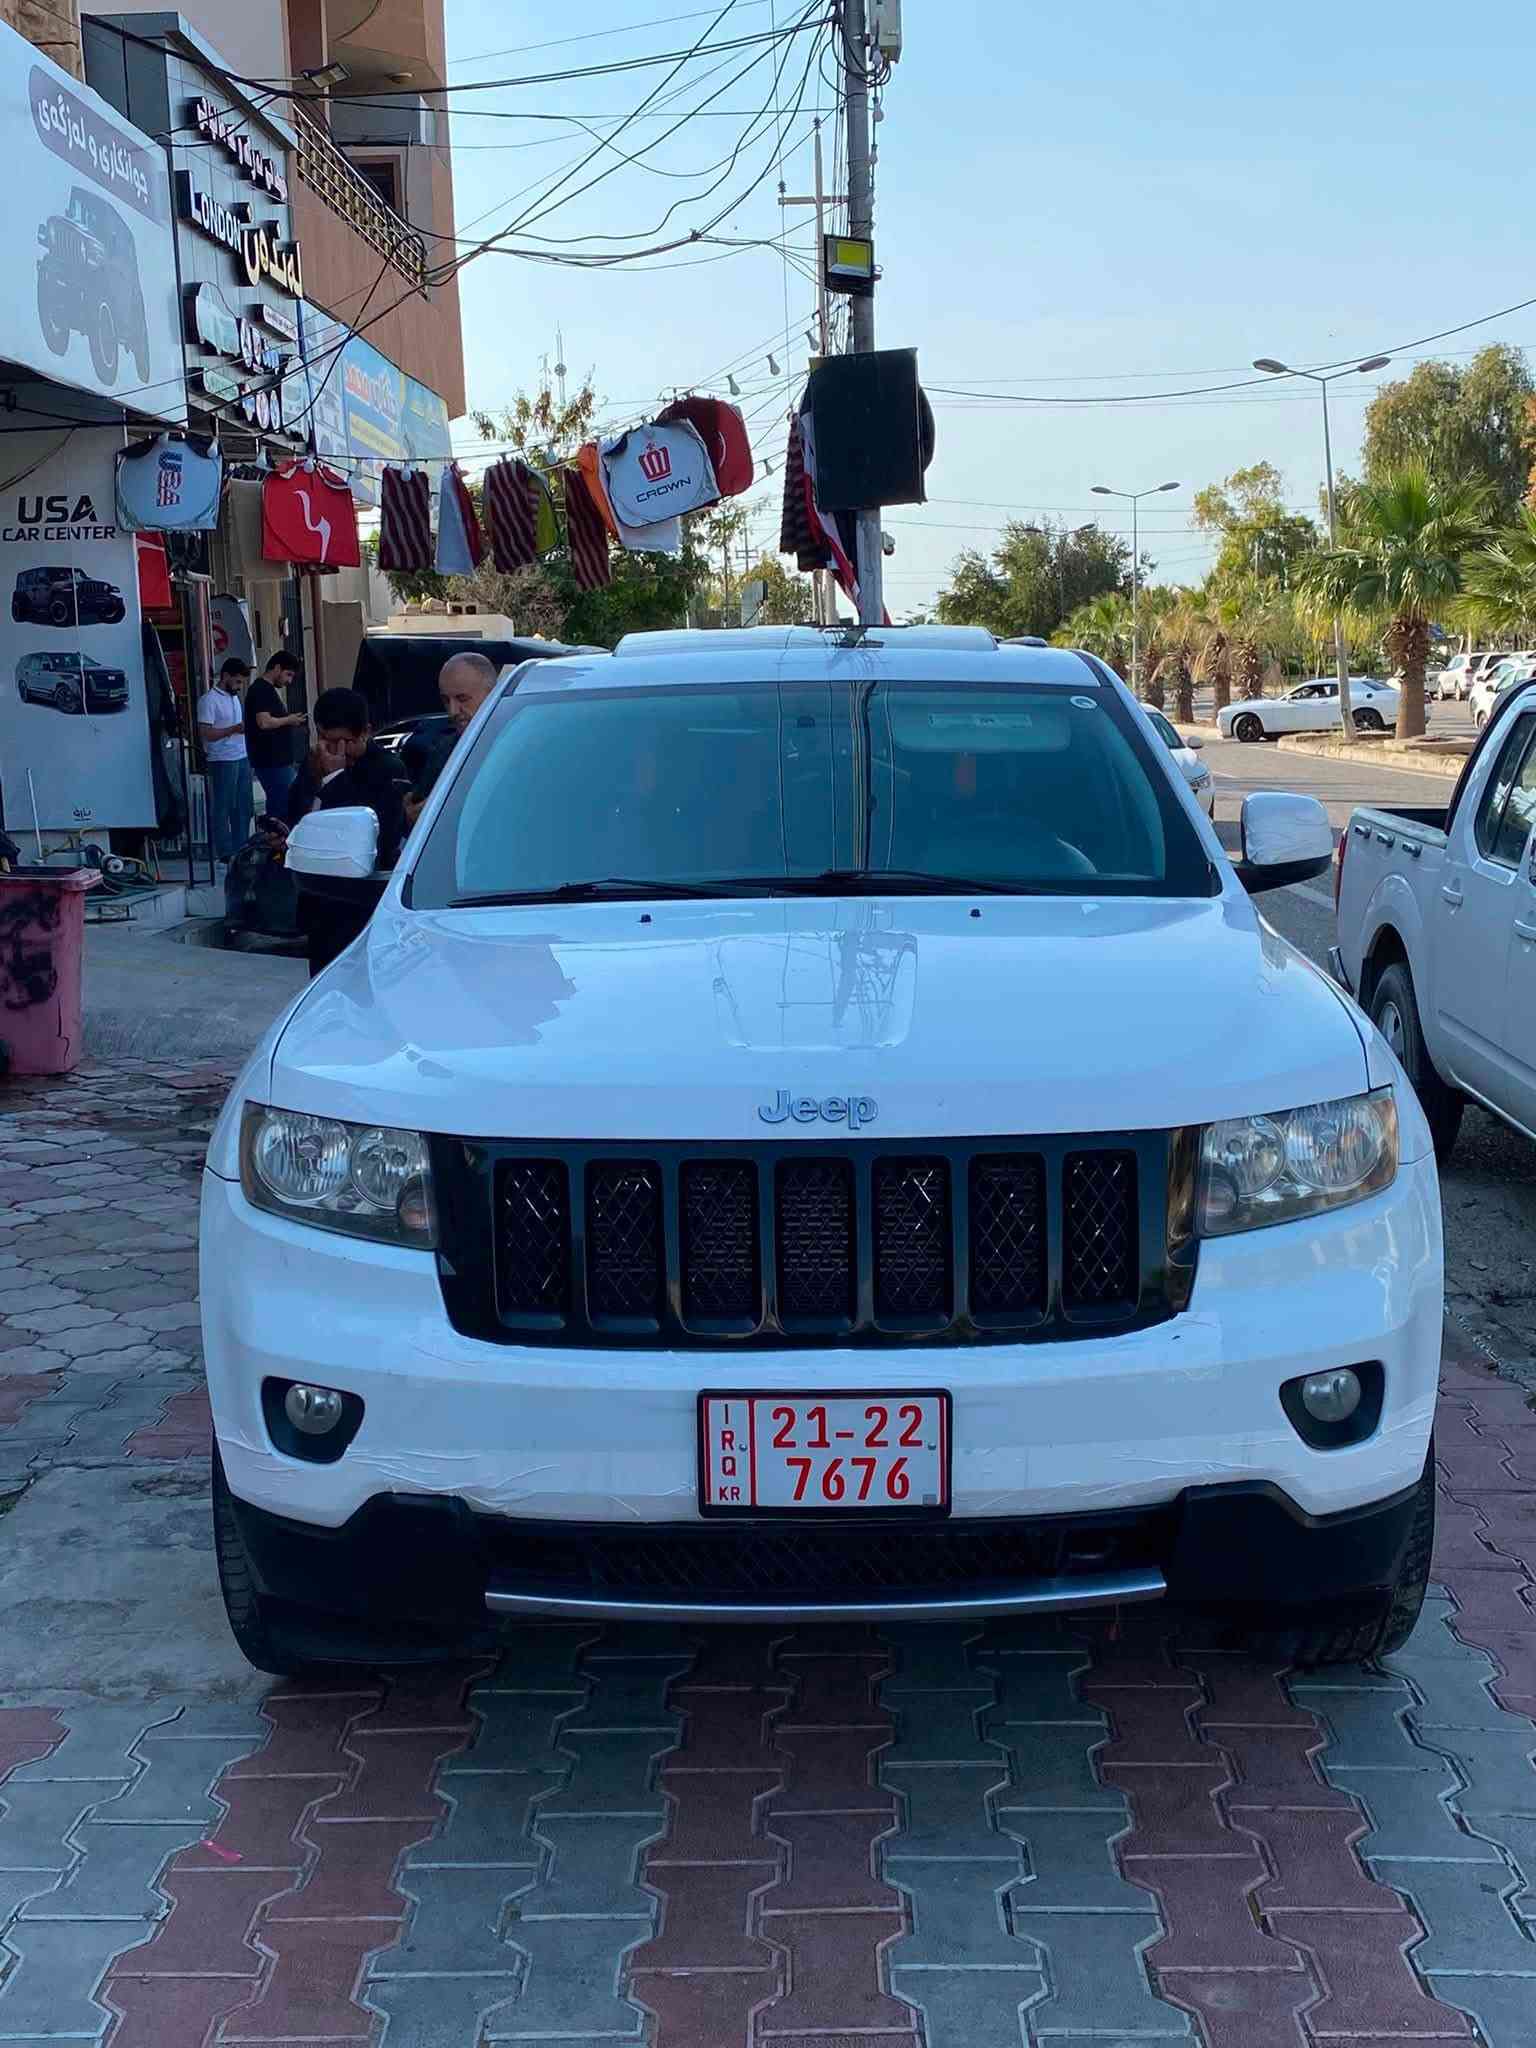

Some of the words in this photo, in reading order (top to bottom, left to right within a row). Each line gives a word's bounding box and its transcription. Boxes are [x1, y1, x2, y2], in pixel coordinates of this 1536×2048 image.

[635, 475, 692, 504] CROWN
[17, 494, 98, 525] USA
[2, 527, 41, 542] CAR
[44, 525, 117, 541] CENTER
[757, 1088, 880, 1131] Jeep
[770, 1404, 924, 1449] 21-22
[718, 1485, 741, 1501] KR
[785, 1456, 911, 1502] 7676
